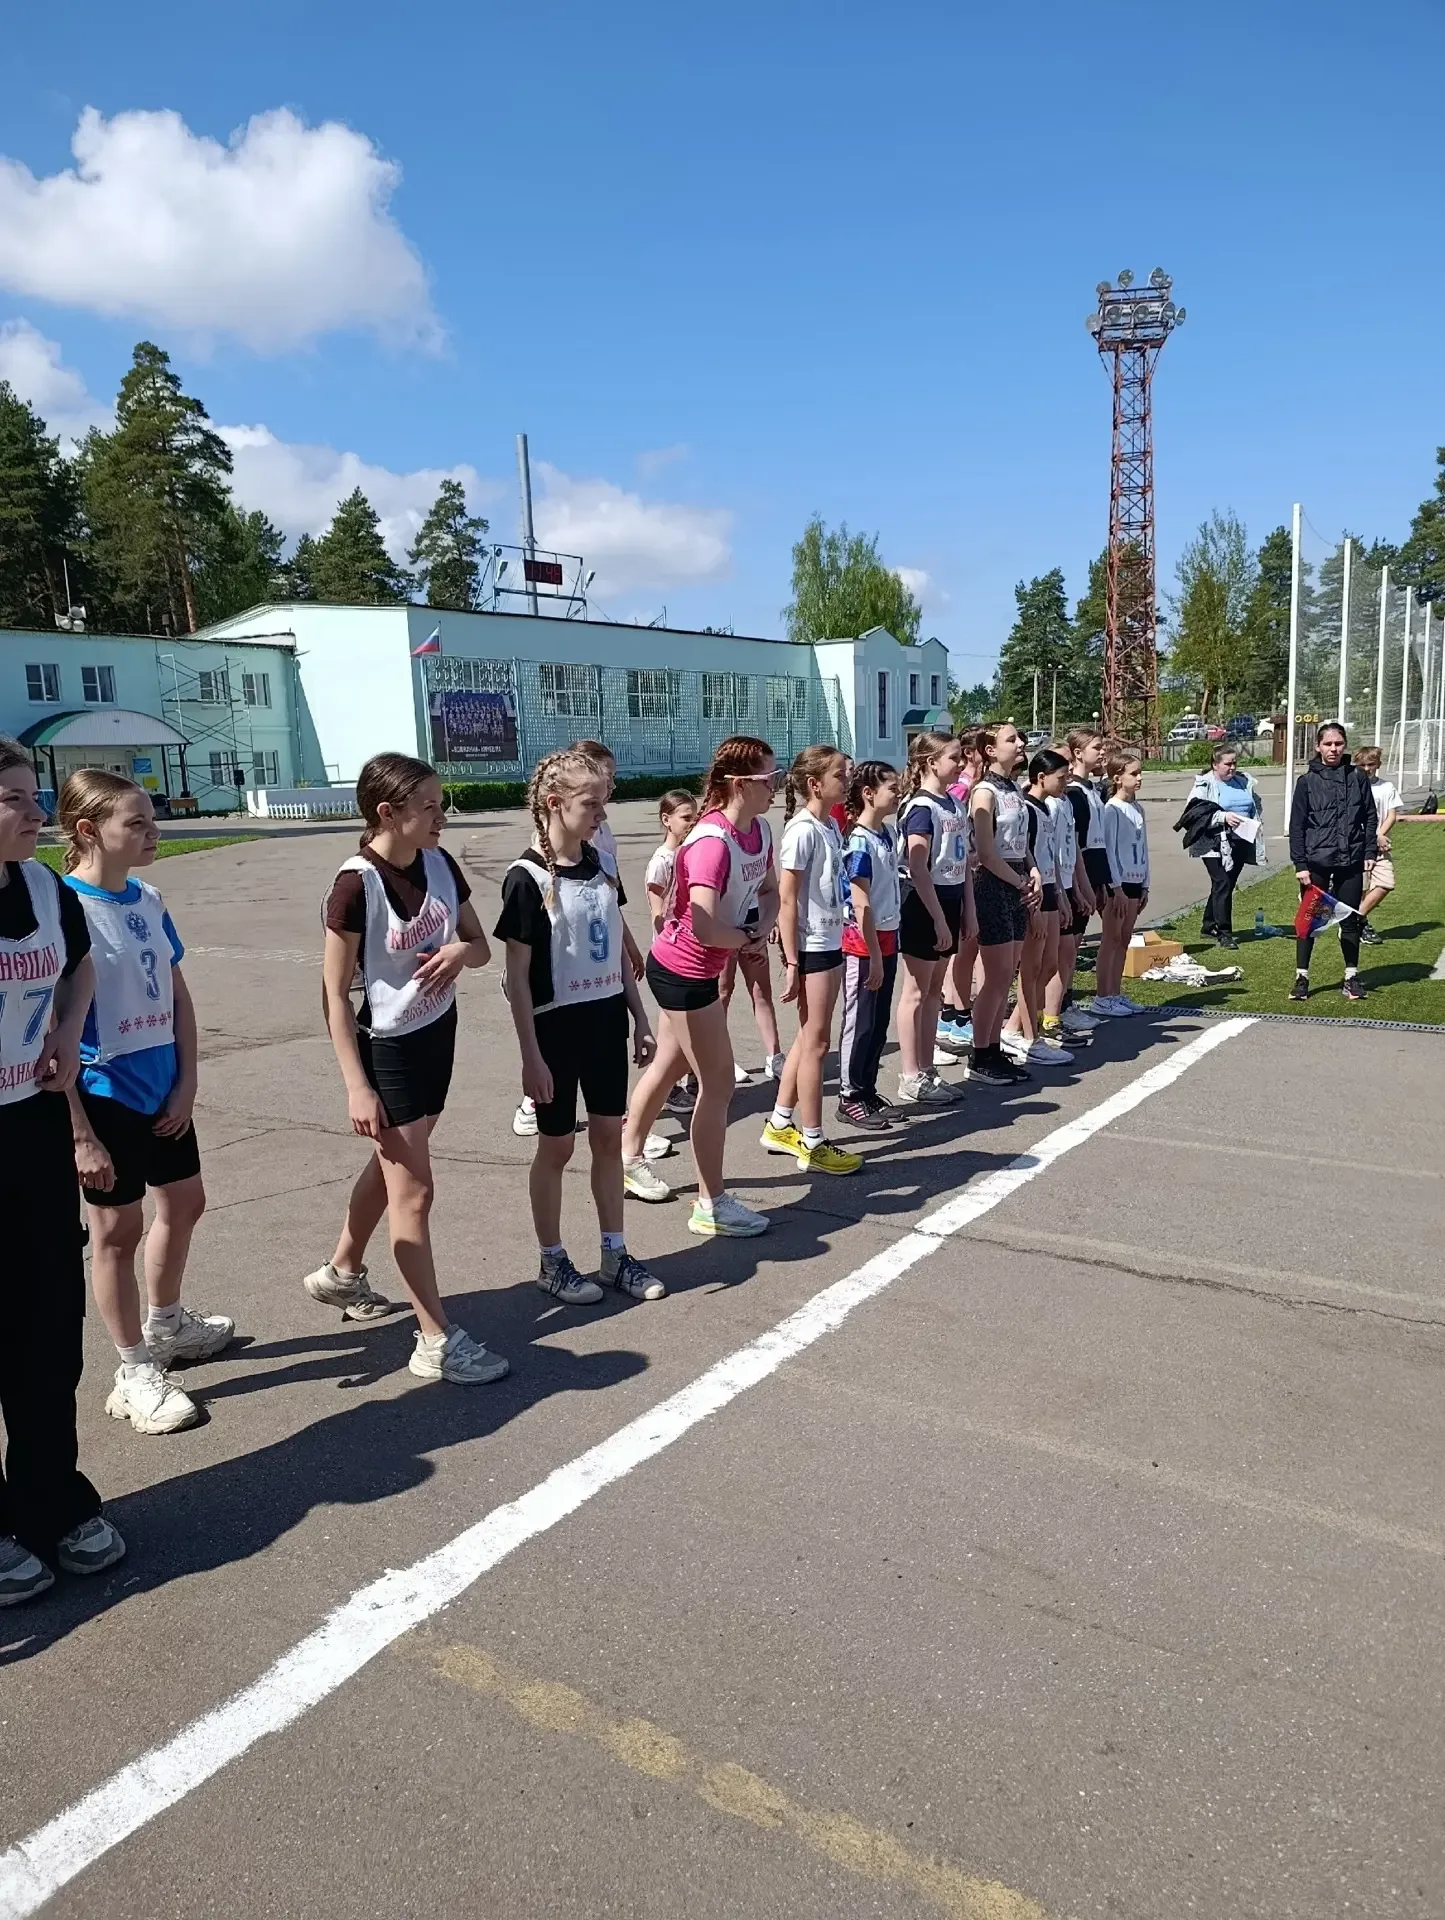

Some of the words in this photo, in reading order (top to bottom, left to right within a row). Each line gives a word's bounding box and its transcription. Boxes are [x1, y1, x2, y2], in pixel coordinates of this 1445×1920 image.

[1295, 714, 1318, 723] ОФЕ
[954, 834, 965, 862] 6
[587, 917, 609, 964] 9
